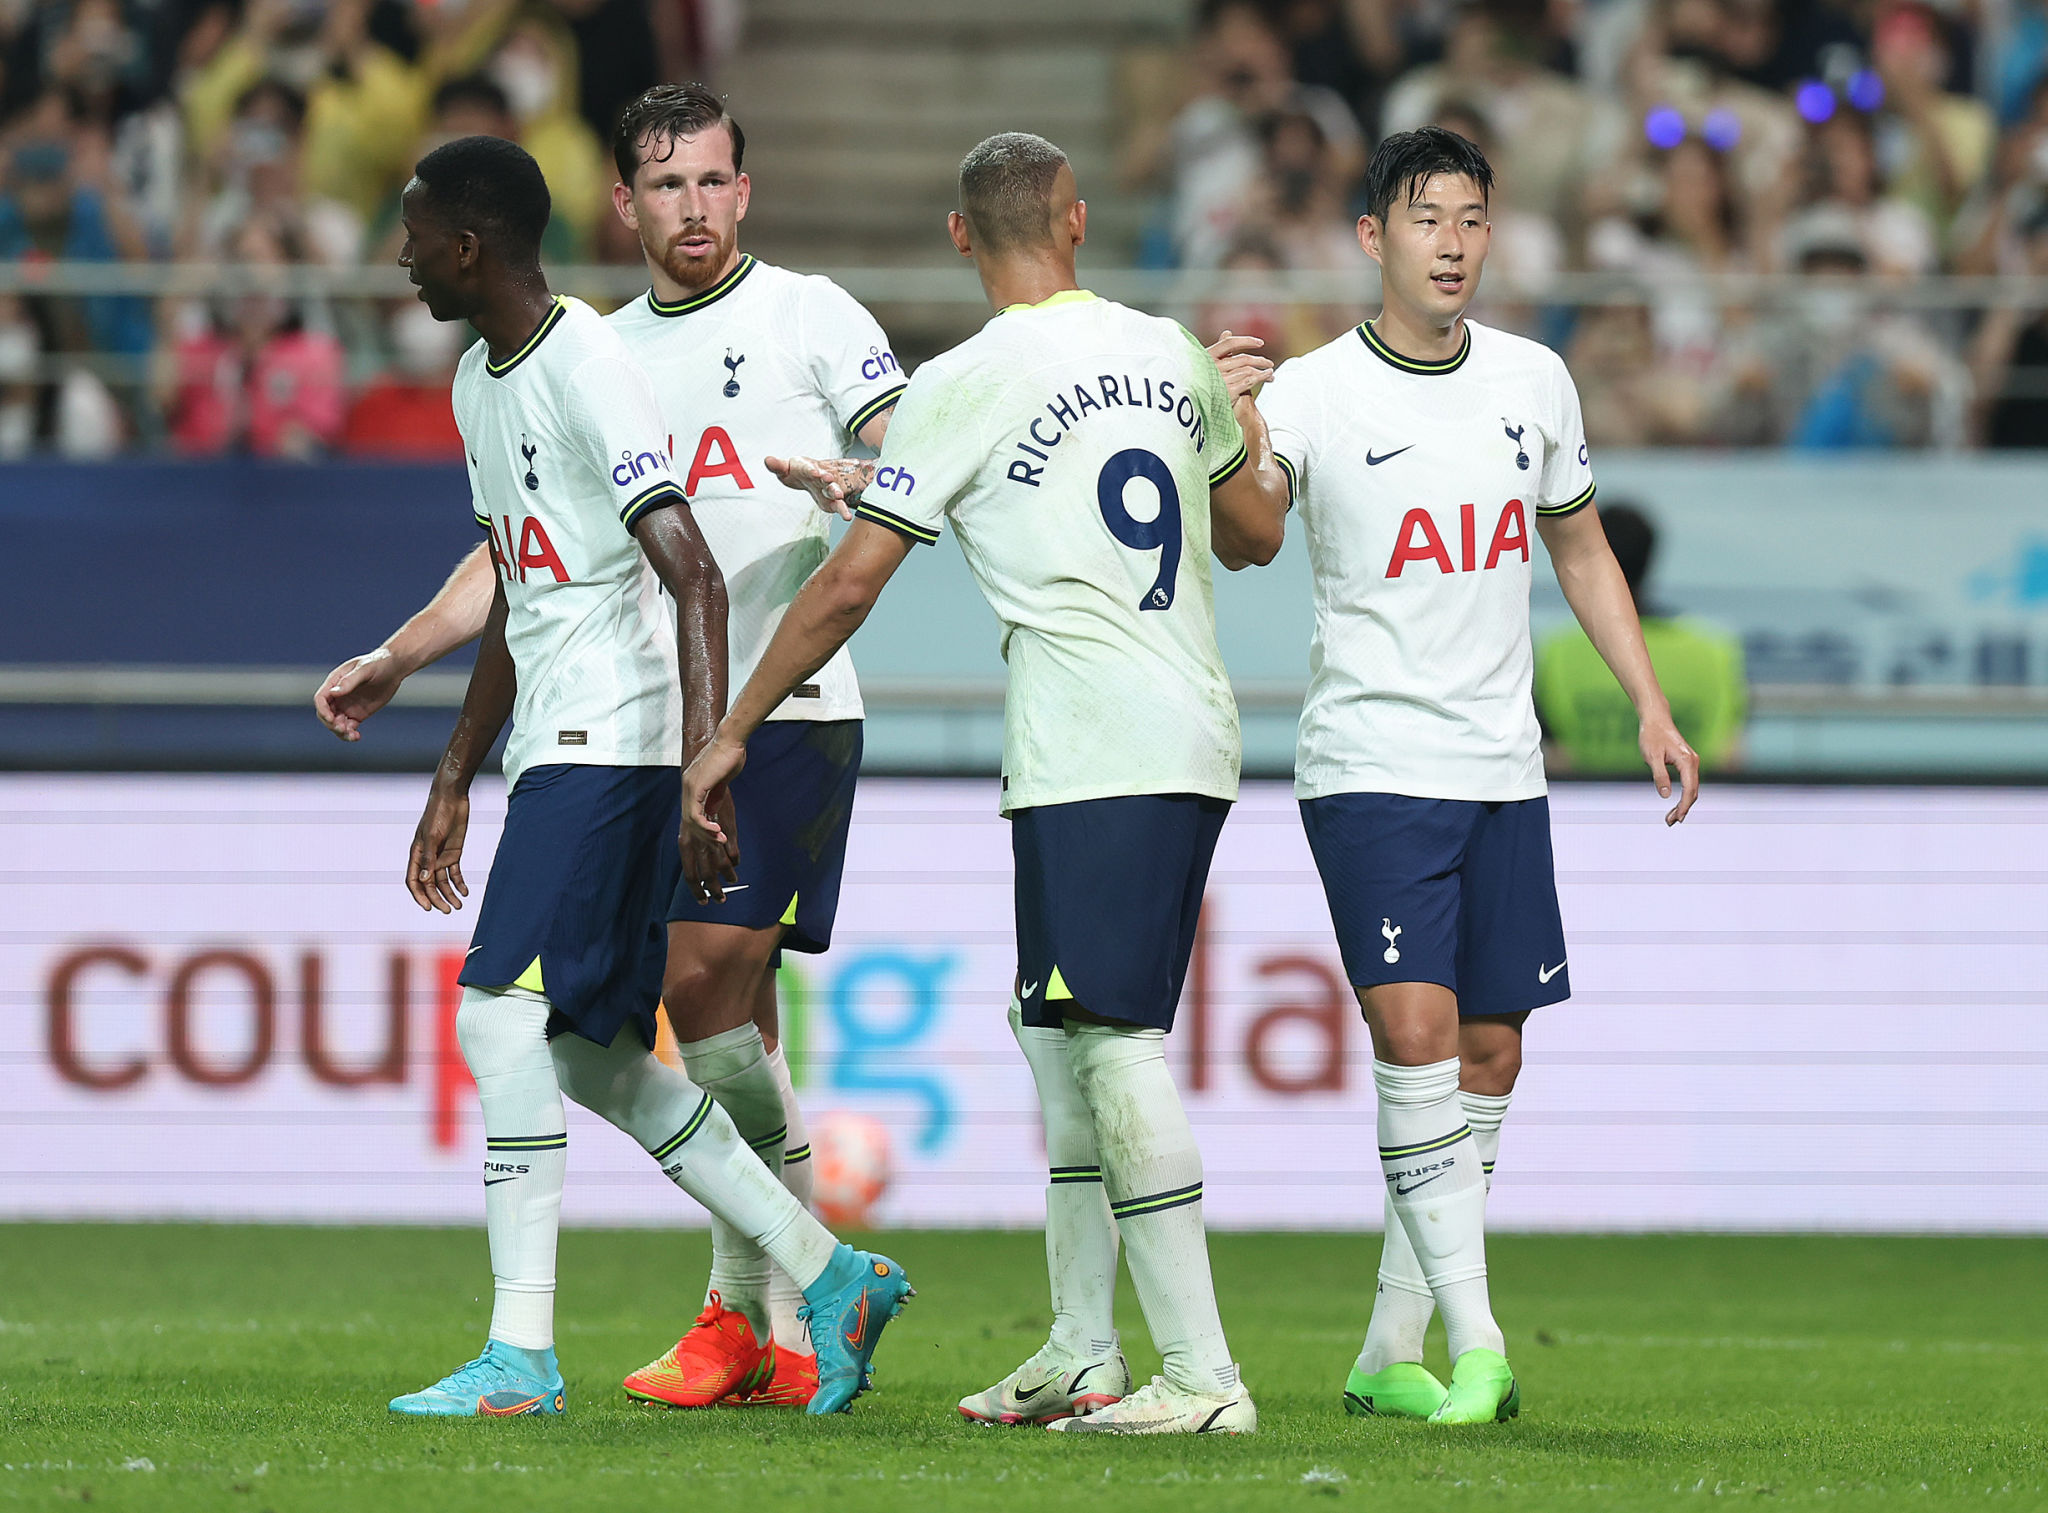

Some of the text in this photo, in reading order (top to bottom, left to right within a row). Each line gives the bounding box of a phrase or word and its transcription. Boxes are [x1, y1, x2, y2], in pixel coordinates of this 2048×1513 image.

[862, 346, 900, 381] cin
[1007, 375, 1205, 488] RICHARLISON
[612, 450, 671, 487] cin
[1097, 447, 1183, 612] 9
[1385, 498, 1530, 579] AIA
[1386, 1157, 1455, 1182] SPURS
